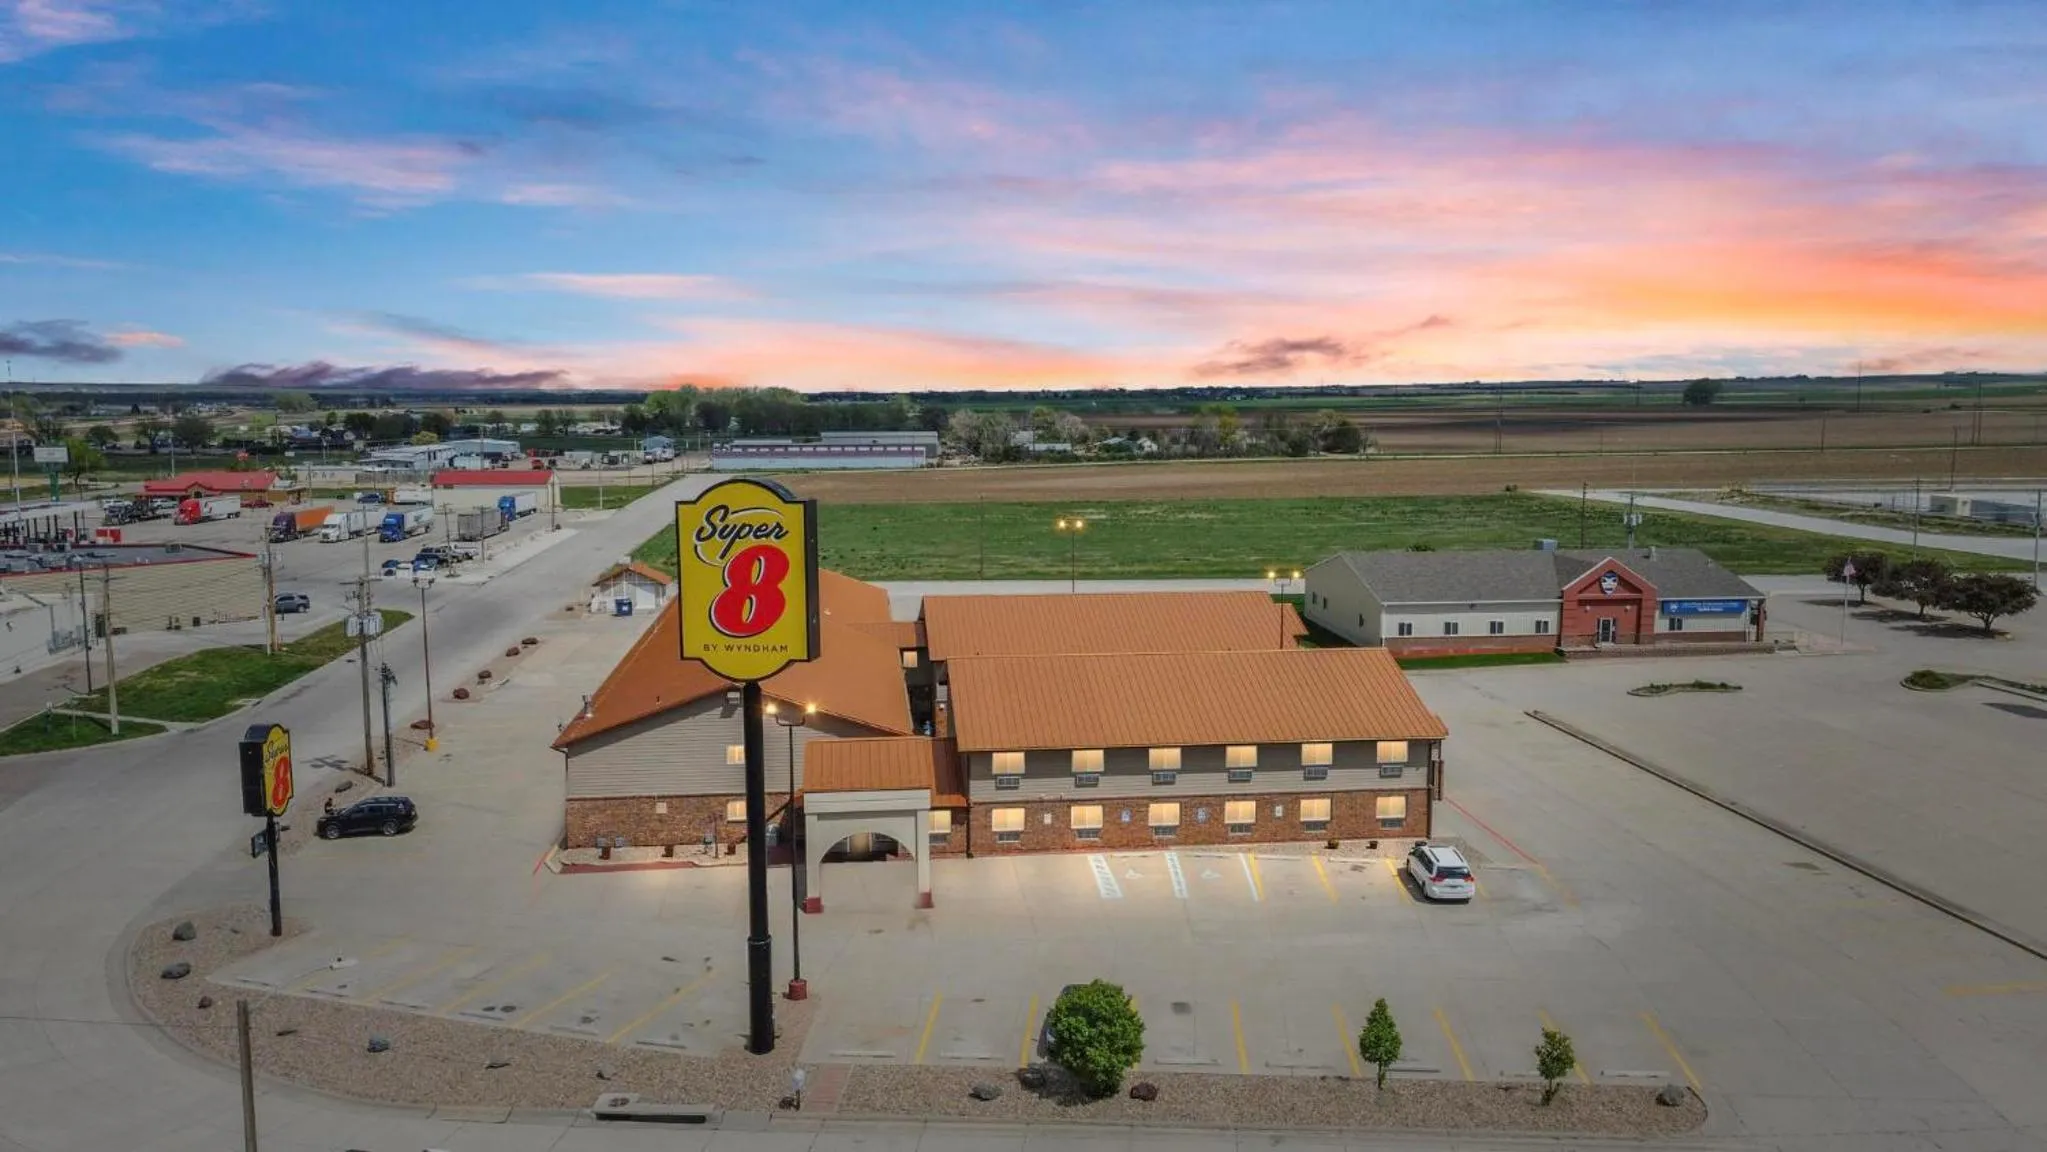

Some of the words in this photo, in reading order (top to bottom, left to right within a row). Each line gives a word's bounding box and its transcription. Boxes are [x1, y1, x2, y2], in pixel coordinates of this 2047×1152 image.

[694, 504, 790, 562] Super
[709, 544, 790, 637] 8
[703, 643, 718, 652] BY
[724, 643, 788, 653] WYNDHAM
[264, 740, 289, 764] Super
[272, 755, 290, 809] 8
